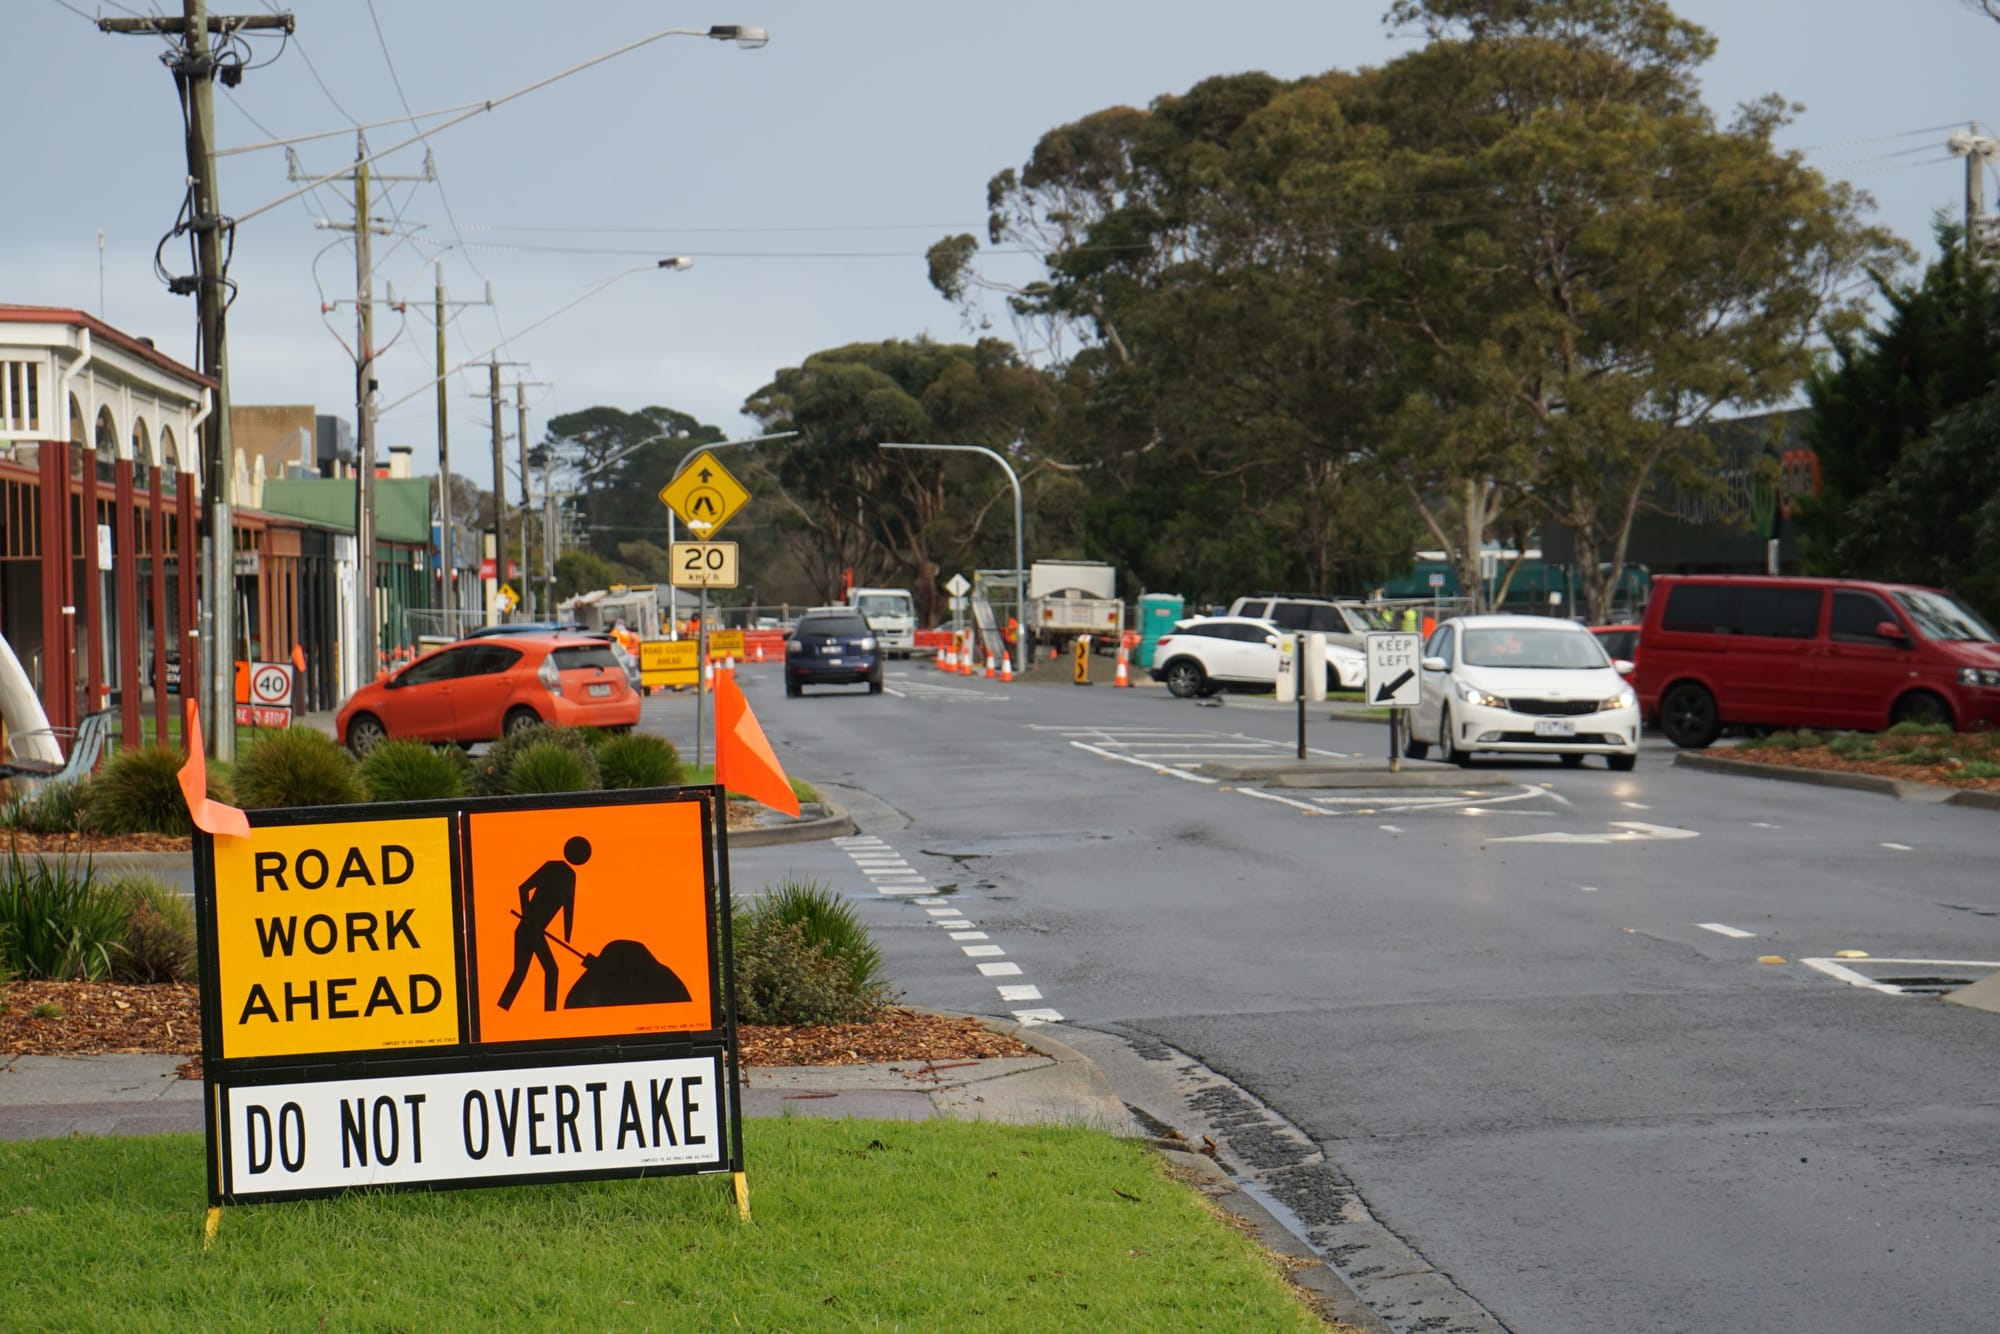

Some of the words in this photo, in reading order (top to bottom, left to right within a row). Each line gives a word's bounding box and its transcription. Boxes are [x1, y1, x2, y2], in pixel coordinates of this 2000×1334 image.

[685, 548, 724, 570] 20
[688, 573, 720, 581] km/h
[1377, 640, 1412, 651] KEEP
[1379, 655, 1411, 666] LEFT
[259, 676, 284, 692] 40
[265, 710, 286, 724] STOP
[255, 845, 414, 892] ROAD
[255, 909, 420, 957] WORK
[239, 974, 442, 1024] AHEAD
[247, 1102, 306, 1174] DO
[341, 1094, 426, 1168] NOT
[463, 1077, 706, 1160] OVERTAKE
